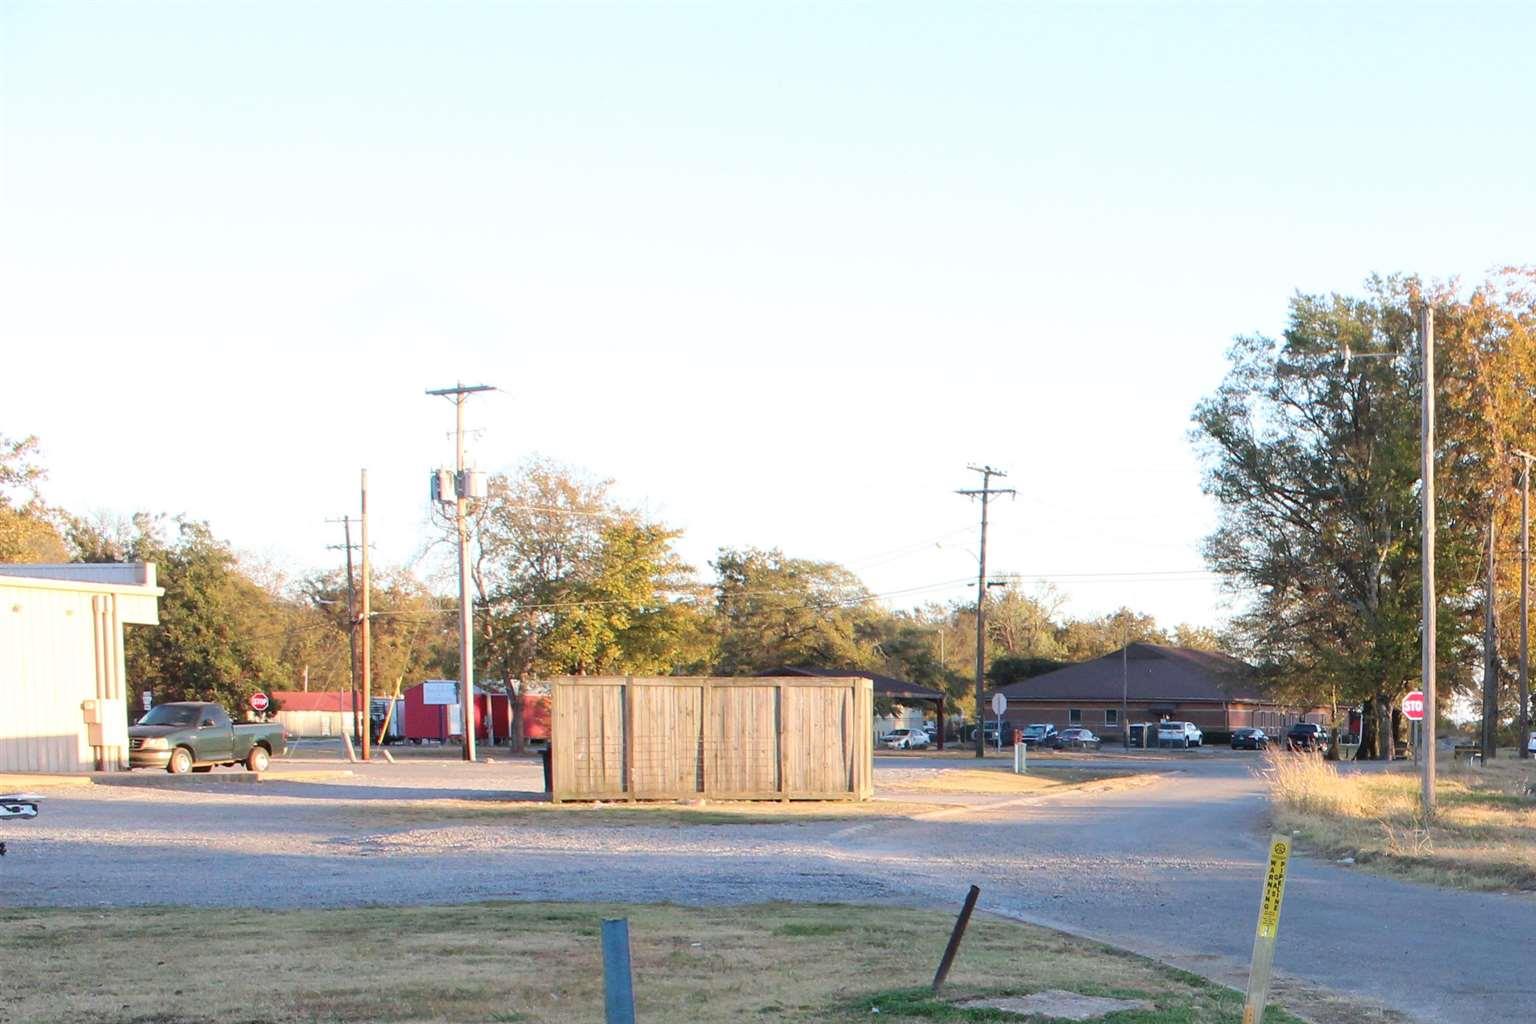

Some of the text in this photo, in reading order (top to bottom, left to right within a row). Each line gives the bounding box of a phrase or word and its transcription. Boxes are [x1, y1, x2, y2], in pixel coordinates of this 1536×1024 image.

[253, 698, 267, 706] STOP
[1405, 701, 1424, 711] STO
[1264, 860, 1276, 910] WARNING
[1271, 874, 1279, 897] GAS
[1273, 861, 1285, 911] PIPELINE
